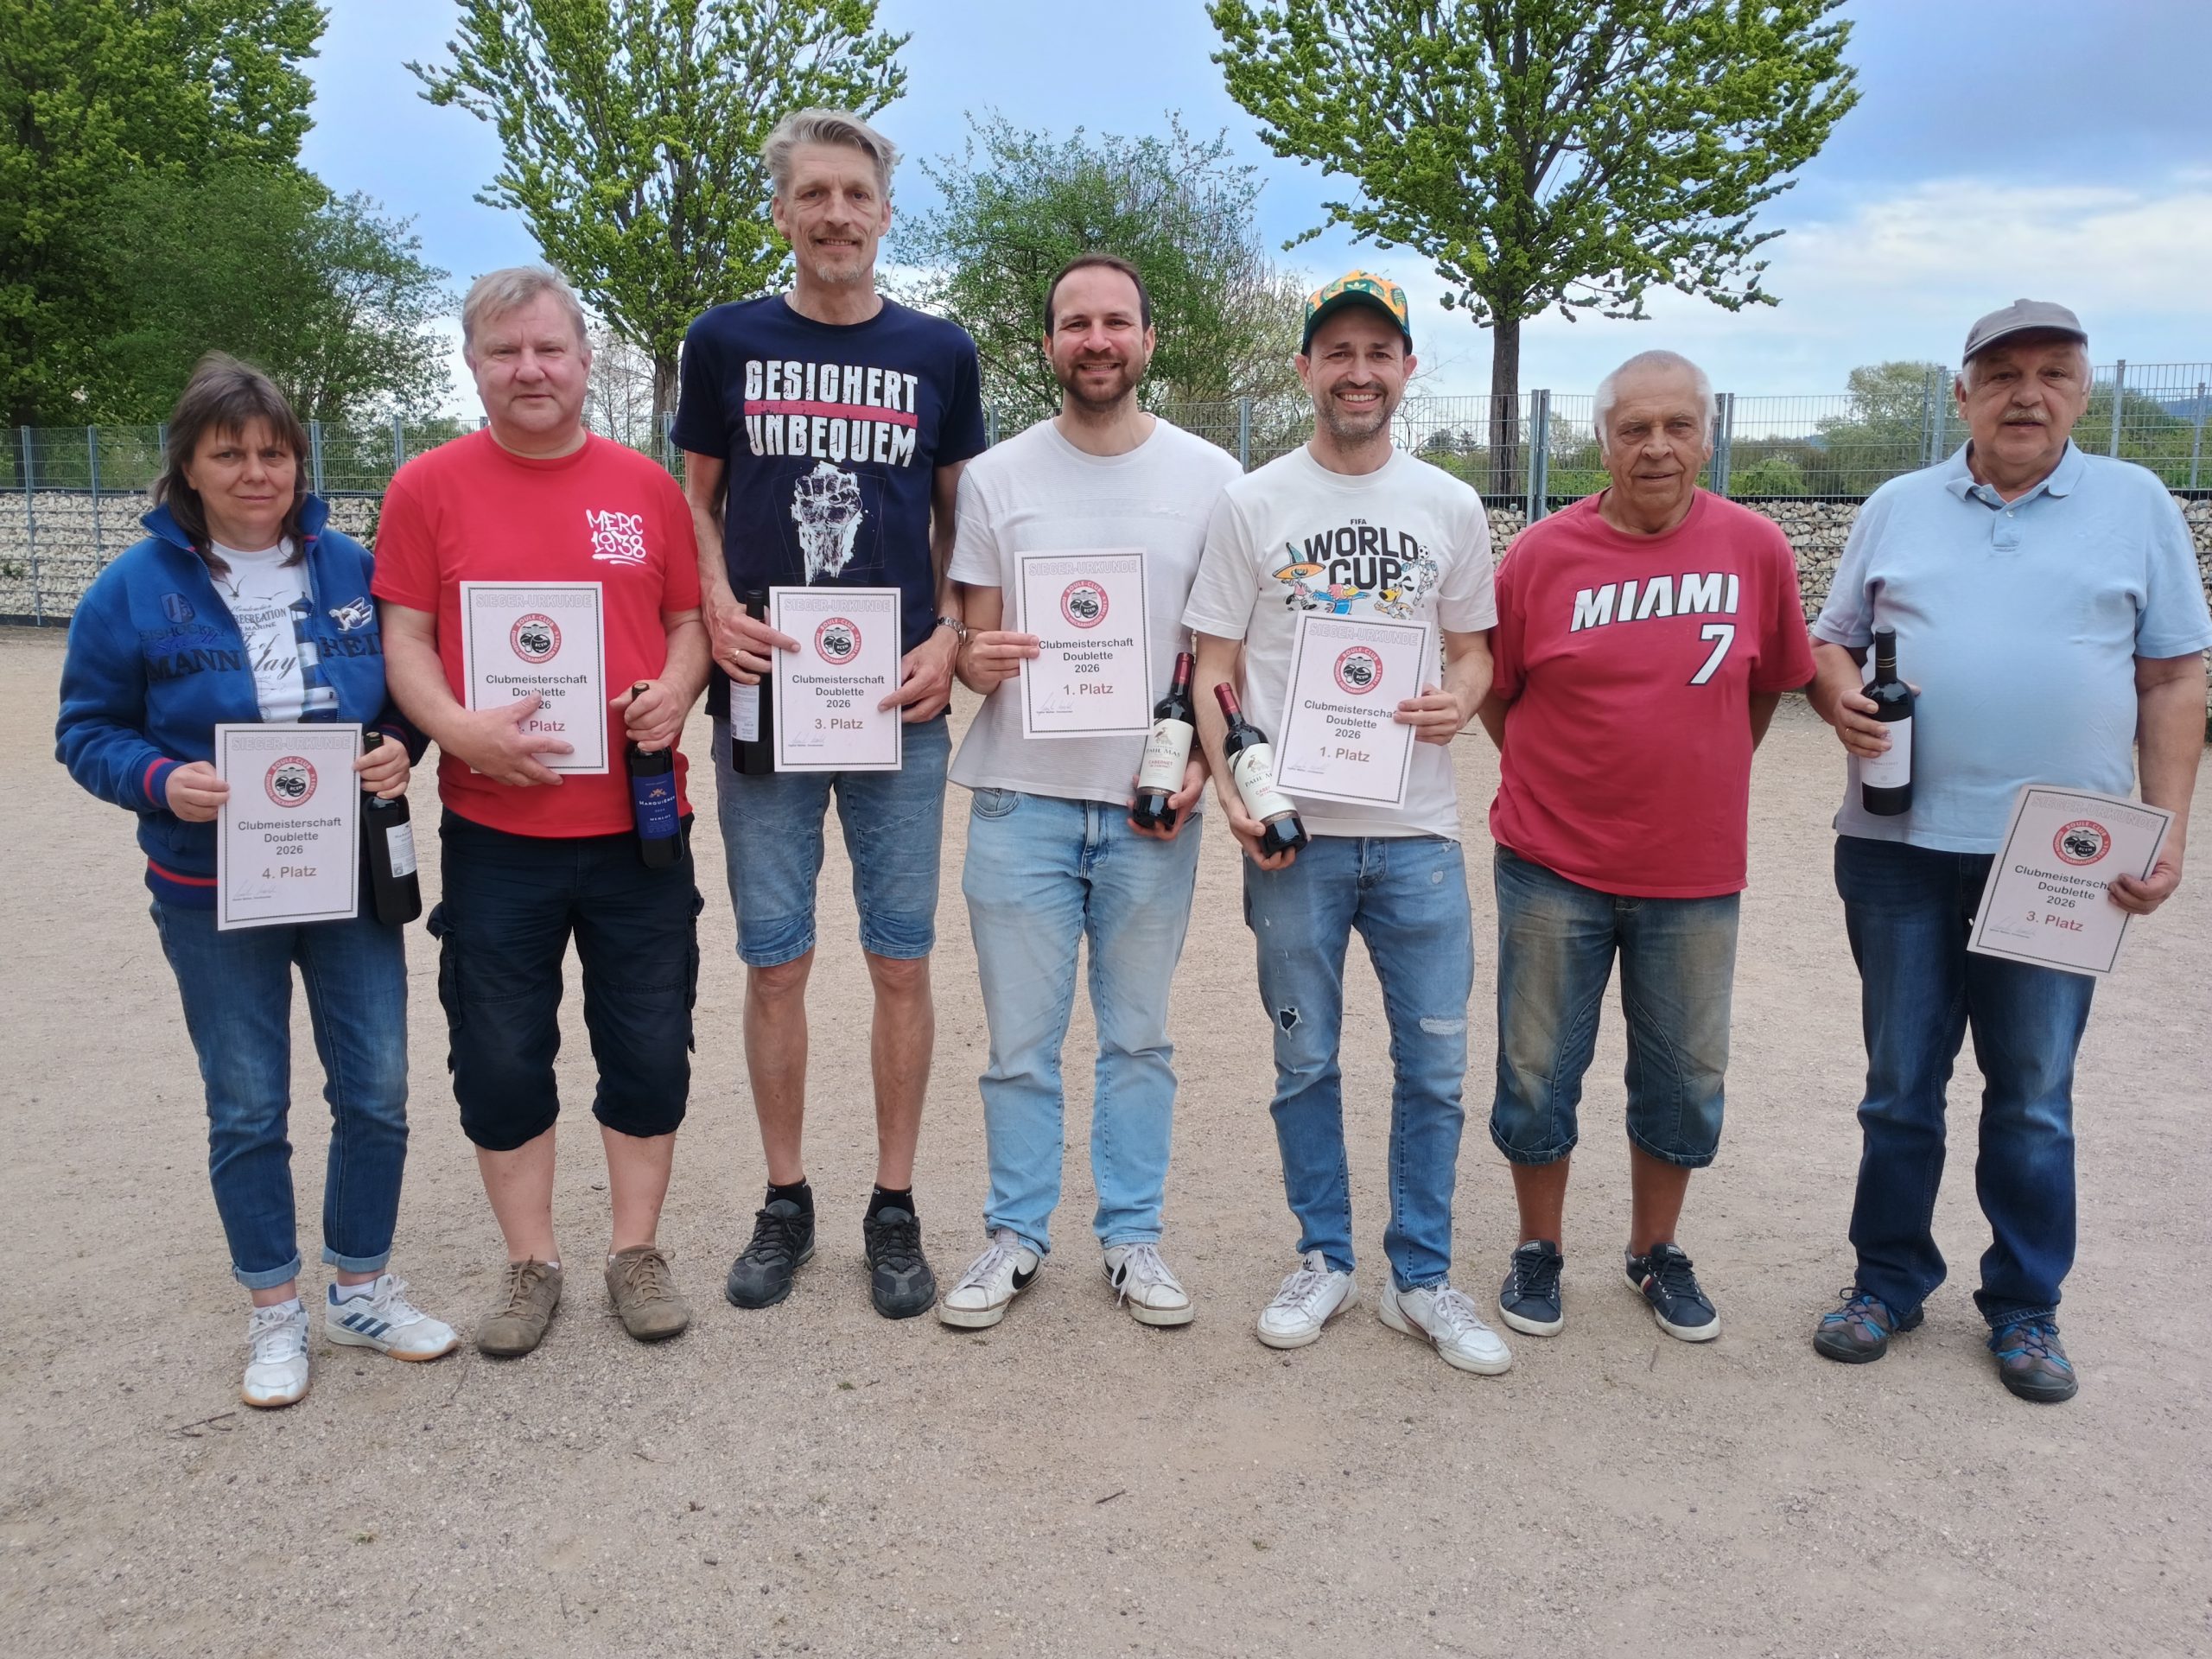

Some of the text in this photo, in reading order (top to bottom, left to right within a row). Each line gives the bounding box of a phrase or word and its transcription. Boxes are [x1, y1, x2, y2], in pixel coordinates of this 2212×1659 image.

[745, 359, 918, 413] GESICHERT
[745, 415, 916, 467] UNBEQUEM
[586, 509, 644, 535] MERC
[590, 531, 646, 559] 1938
[1304, 526, 1418, 563] WORLD
[1029, 559, 1137, 576] SIEGER-URKUNDE
[1329, 557, 1402, 590] CUP
[476, 594, 592, 608] SIEGER-URKUNDE
[785, 598, 891, 613] SIEGER-URKUNDE
[1569, 572, 1739, 633] MIAMI
[1039, 638, 1134, 649] Clubmeisterschaft
[1063, 652, 1114, 661] Doublette
[1688, 623, 1736, 685] 7
[1074, 664, 1100, 673] 2026
[486, 675, 588, 684] Clubmeisterschaft
[791, 674, 885, 684] Clubmeisterschaft
[816, 687, 864, 696] Doublette
[1063, 683, 1114, 696] 1. Platz
[538, 701, 551, 709] 26
[826, 699, 851, 709] 2026
[1304, 700, 1395, 719] Clubmeisterscha
[530, 721, 566, 732] Platz
[815, 718, 864, 729] 3. Platz
[1325, 715, 1377, 729] Doublette
[1335, 728, 1362, 740] 2026
[232, 735, 351, 752] SIEGER-URKUNDE
[1319, 746, 1370, 762] 1. Platz
[238, 817, 341, 831] Clubmeisterschaft
[264, 832, 319, 842] Doublette
[276, 845, 303, 855] 2026
[262, 866, 317, 880] 4. Platz
[2014, 865, 2108, 891] Clubmeistersch
[2037, 881, 2095, 900] Doublette
[2046, 895, 2076, 908] 2026
[2026, 910, 2084, 932] 3. Platz
